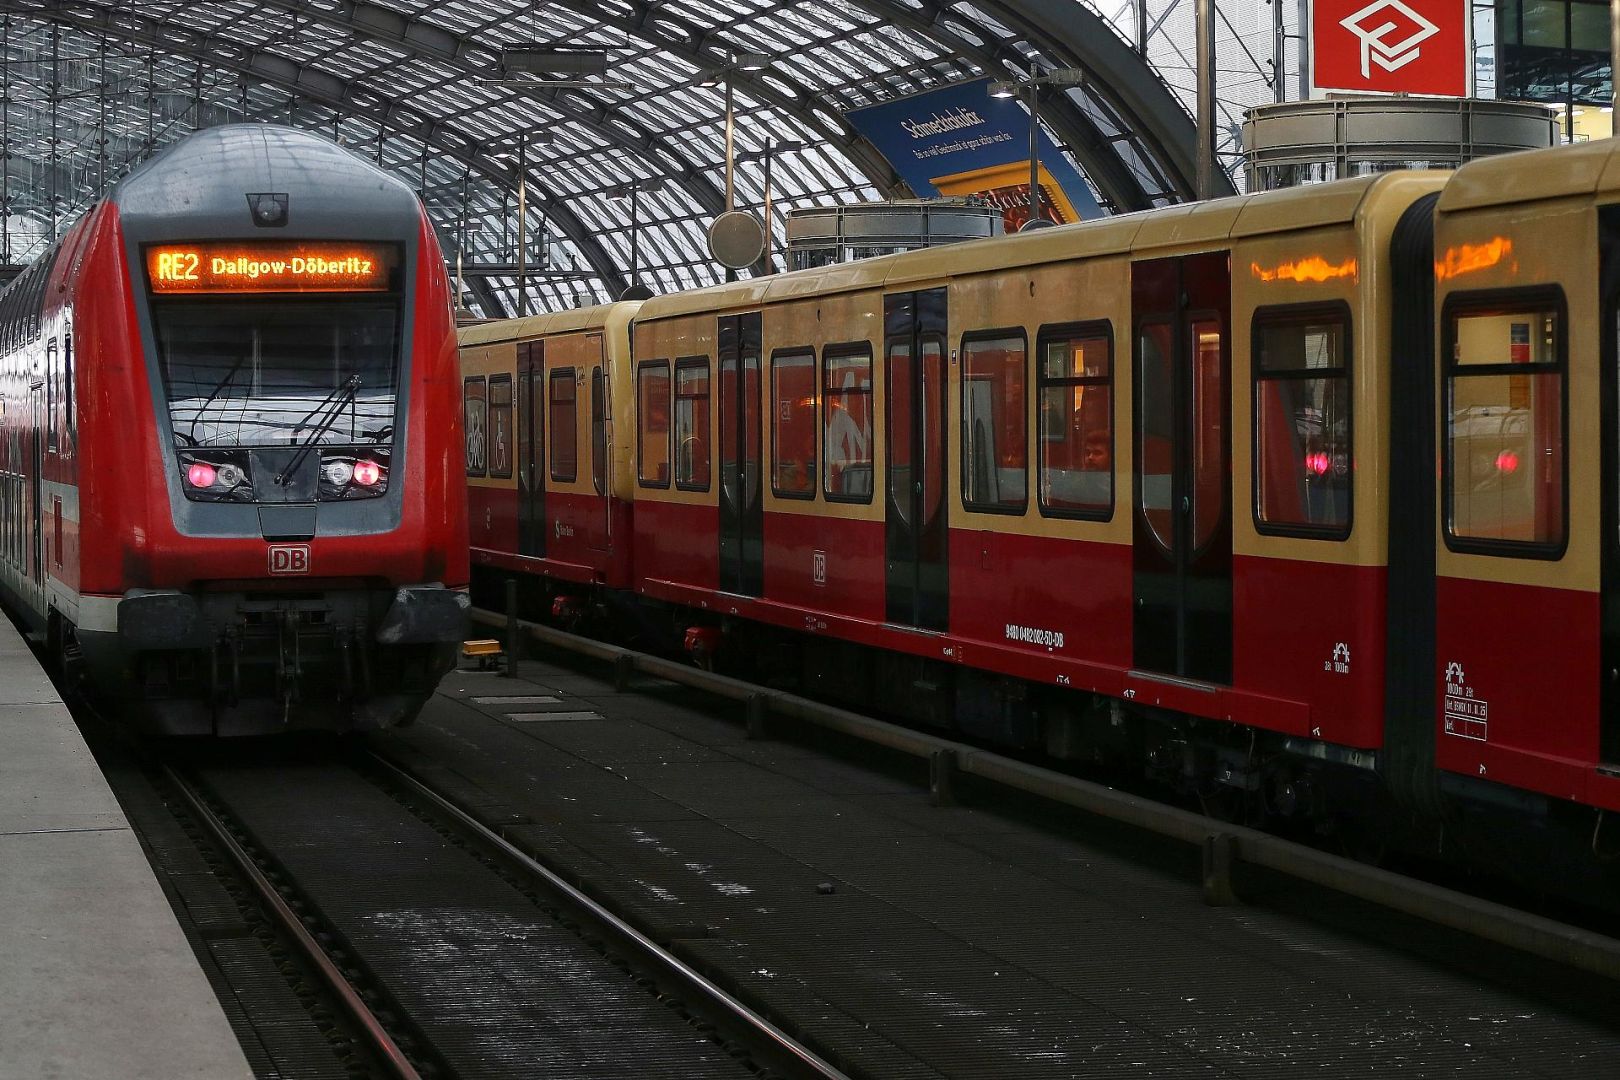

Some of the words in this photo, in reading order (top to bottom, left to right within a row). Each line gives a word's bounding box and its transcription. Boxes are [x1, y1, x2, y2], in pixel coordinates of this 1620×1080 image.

[900, 106, 986, 139] Schmecktakulär.
[966, 139, 981, 150] ganz
[979, 134, 995, 145] schön
[158, 253, 199, 280] RE2
[211, 257, 372, 278] Dallgow-Döberitz
[272, 548, 307, 572] DB
